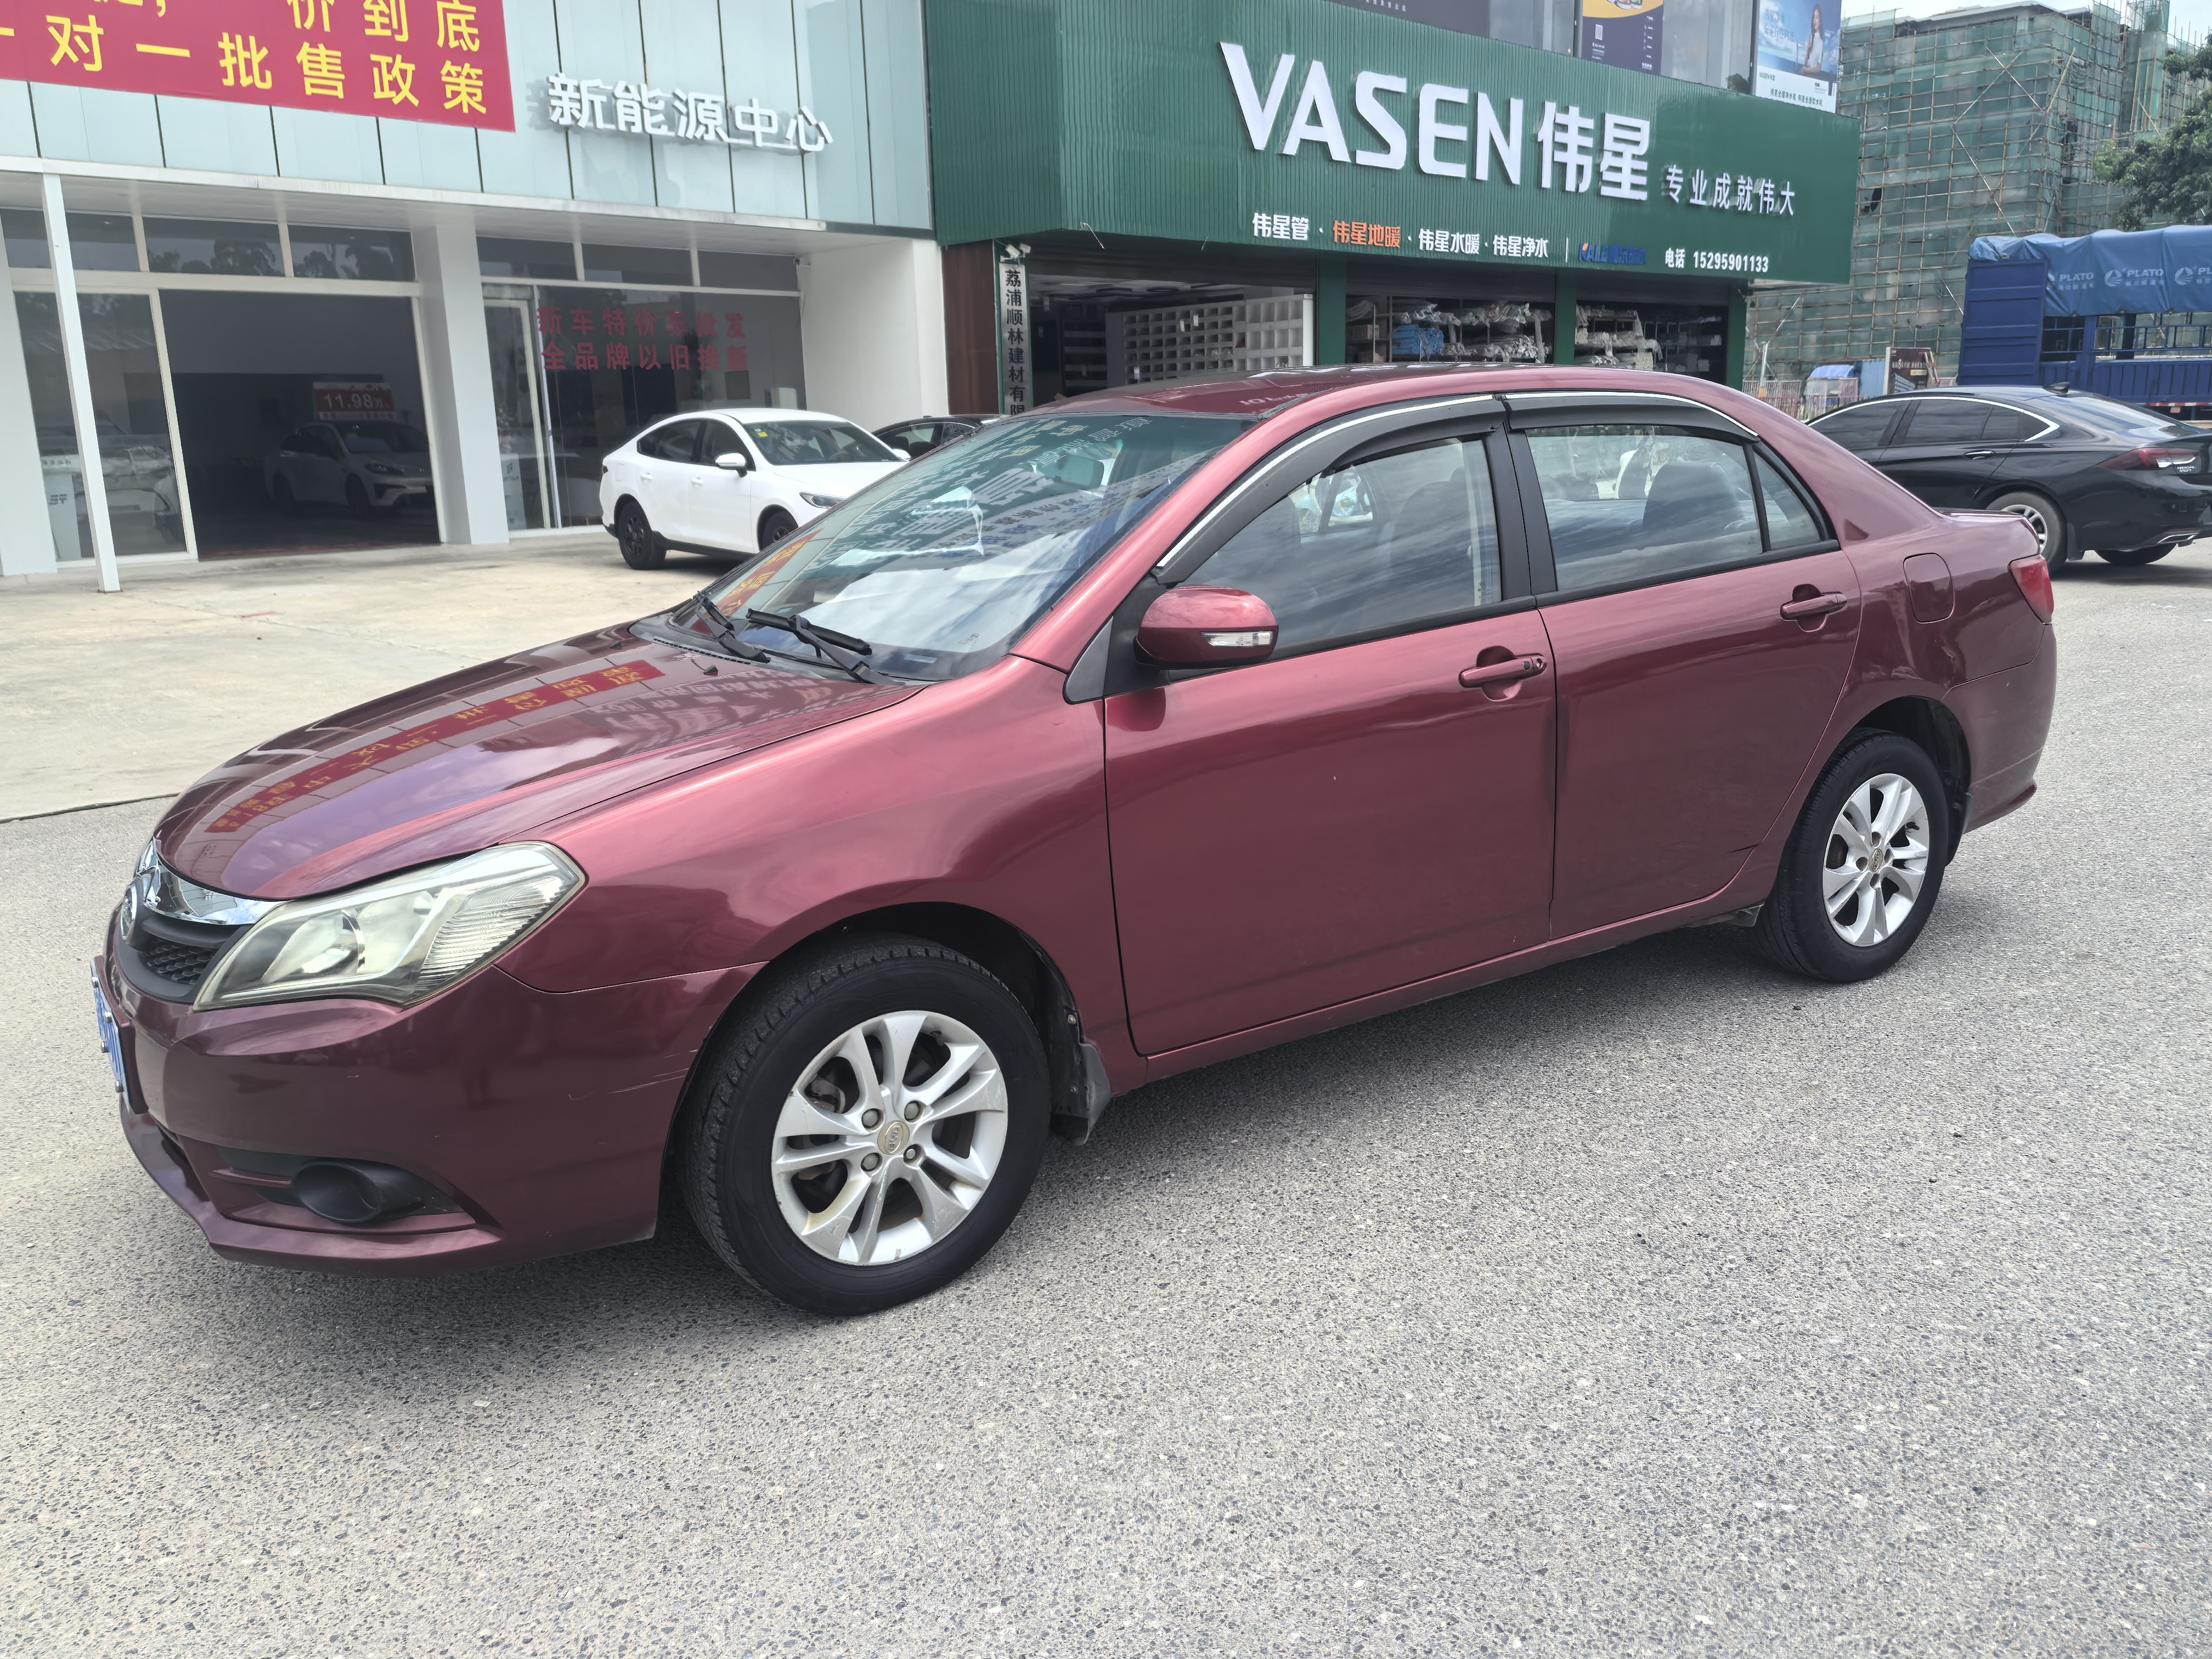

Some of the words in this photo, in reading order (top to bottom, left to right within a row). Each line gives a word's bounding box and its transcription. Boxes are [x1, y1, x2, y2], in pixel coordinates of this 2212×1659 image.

[0, 15, 487, 114] 对一批售政策
[547, 72, 833, 152] 新能源中心
[1219, 41, 1524, 185] VASEN
[1536, 100, 1650, 201] 伟星
[1665, 164, 1795, 215] 专业成就伟大
[1252, 212, 1309, 241] 伟星管
[1332, 220, 1401, 248] 伟星地暖
[1418, 228, 1480, 255] 伟星水暖
[1493, 234, 1549, 258] 伟星净水
[1665, 247, 1686, 268] 电话
[1694, 251, 1769, 273] 15295901133
[2059, 272, 2094, 282] PLATO
[2127, 268, 2164, 278] PLATO
[537, 306, 746, 339] 新车特价车批发
[540, 341, 748, 370] 全品牌以旧换新
